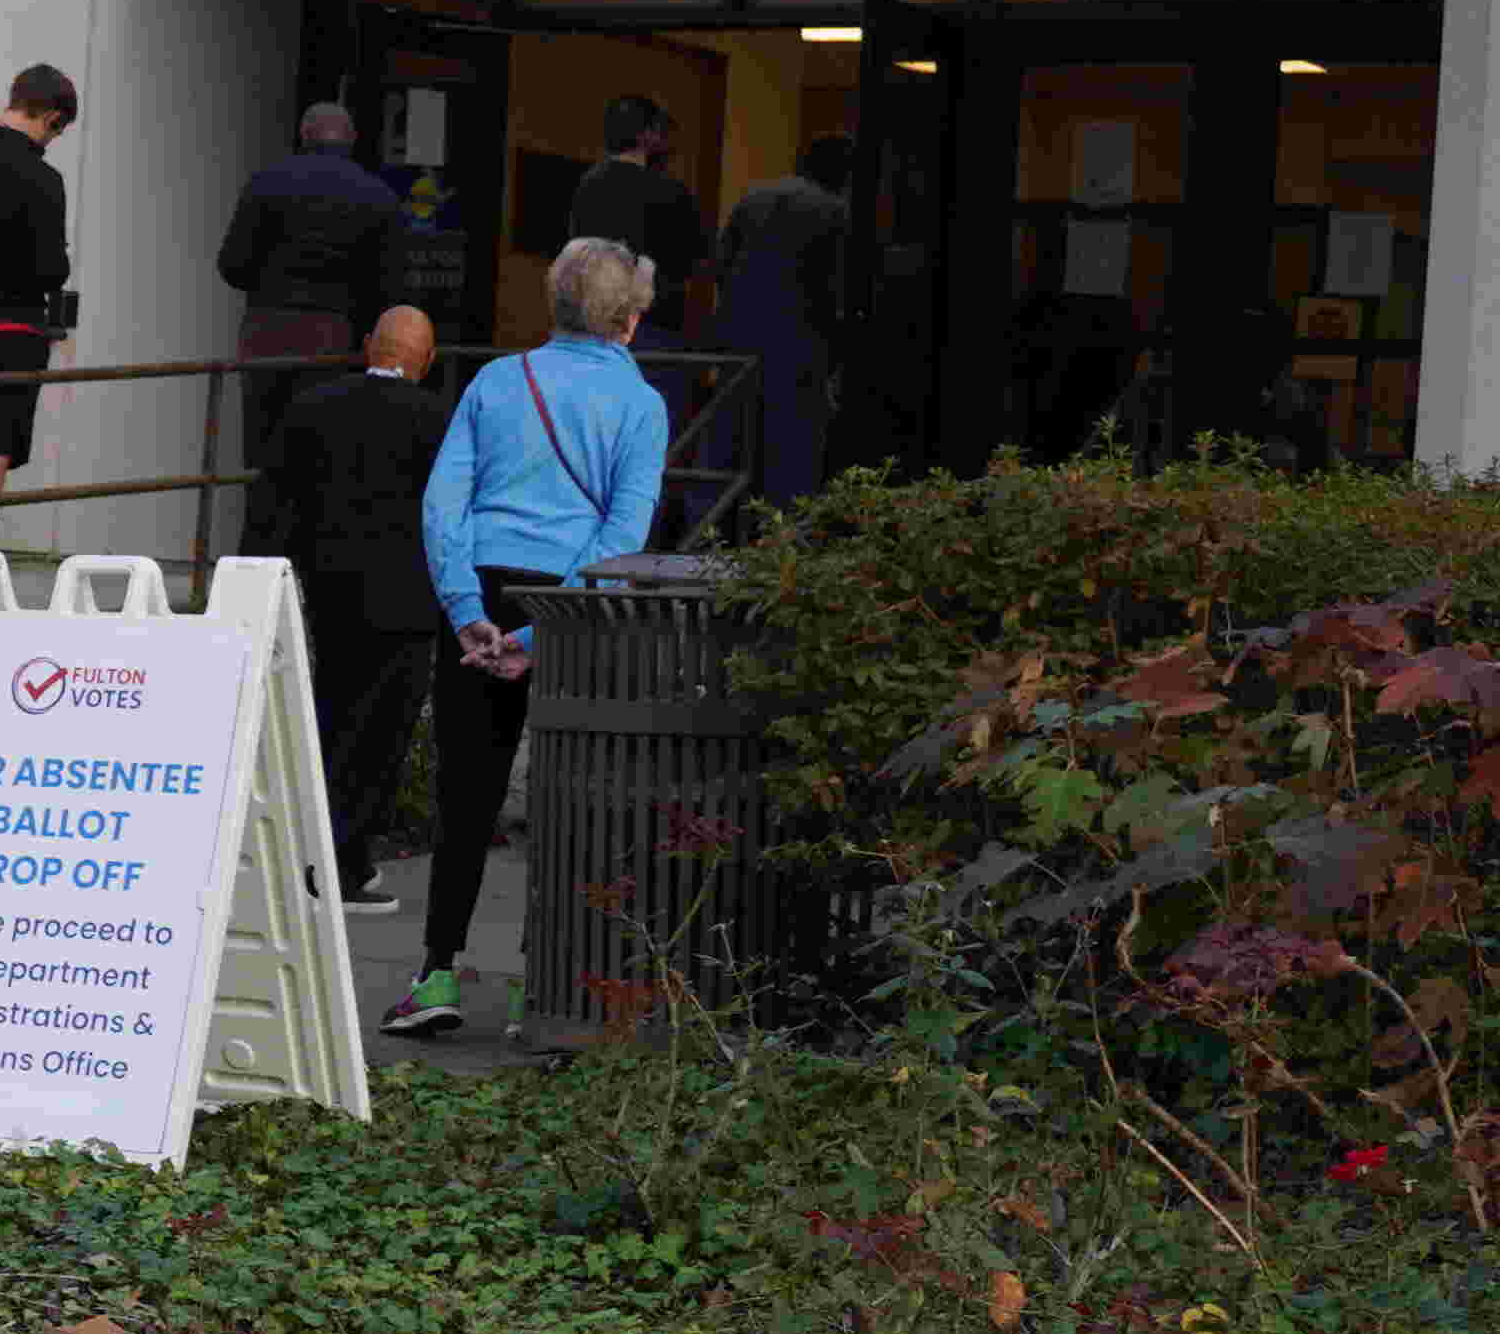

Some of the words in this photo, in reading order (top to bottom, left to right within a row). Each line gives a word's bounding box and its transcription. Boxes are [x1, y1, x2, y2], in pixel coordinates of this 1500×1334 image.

[71, 667, 147, 685] FULTON
[70, 689, 143, 709] VOTES
[11, 757, 204, 795] ABSENTEE
[72, 859, 146, 891] OFF
[11, 917, 137, 942] proceed
[144, 920, 173, 946] to
[133, 1012, 154, 1036] &
[42, 1051, 129, 1079] Office
